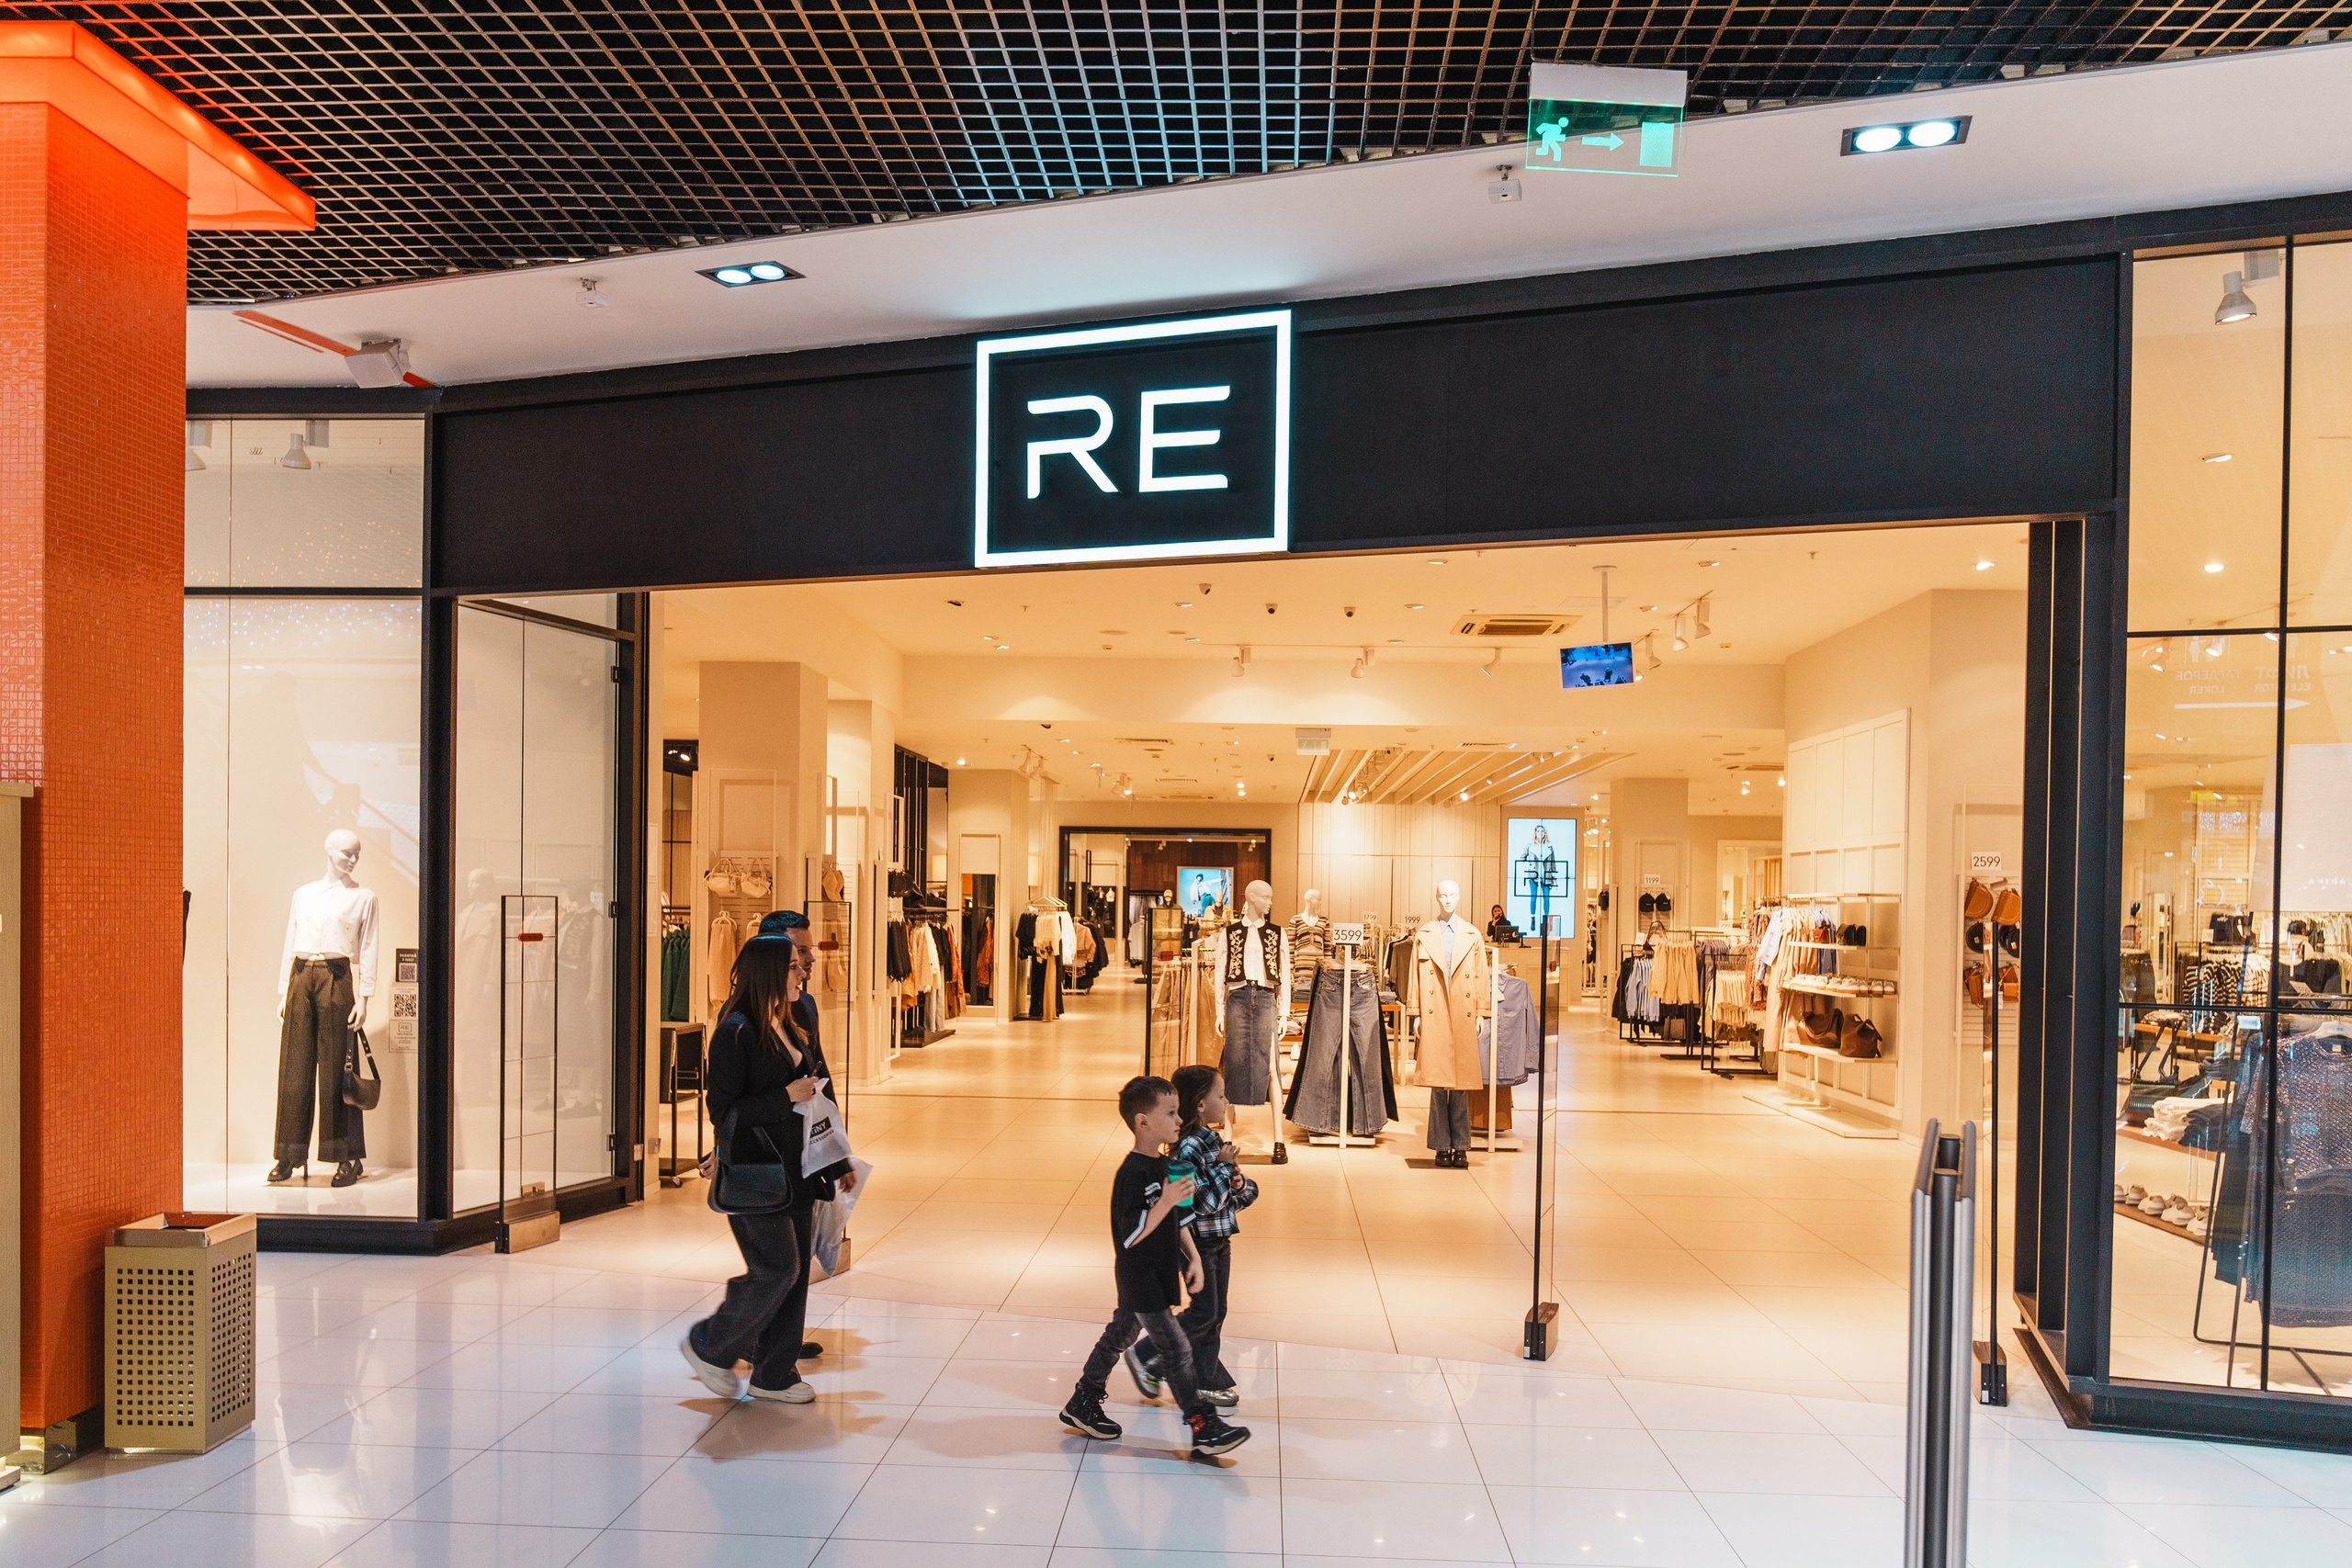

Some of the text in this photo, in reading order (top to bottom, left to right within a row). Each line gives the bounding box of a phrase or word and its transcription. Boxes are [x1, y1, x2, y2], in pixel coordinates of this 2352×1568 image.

[1027, 385, 1231, 500] RE
[1973, 855, 2001, 867] 2599
[1523, 870, 1558, 887] RE
[1405, 916, 1420, 924] 1999
[1333, 929, 1363, 942] 3599
